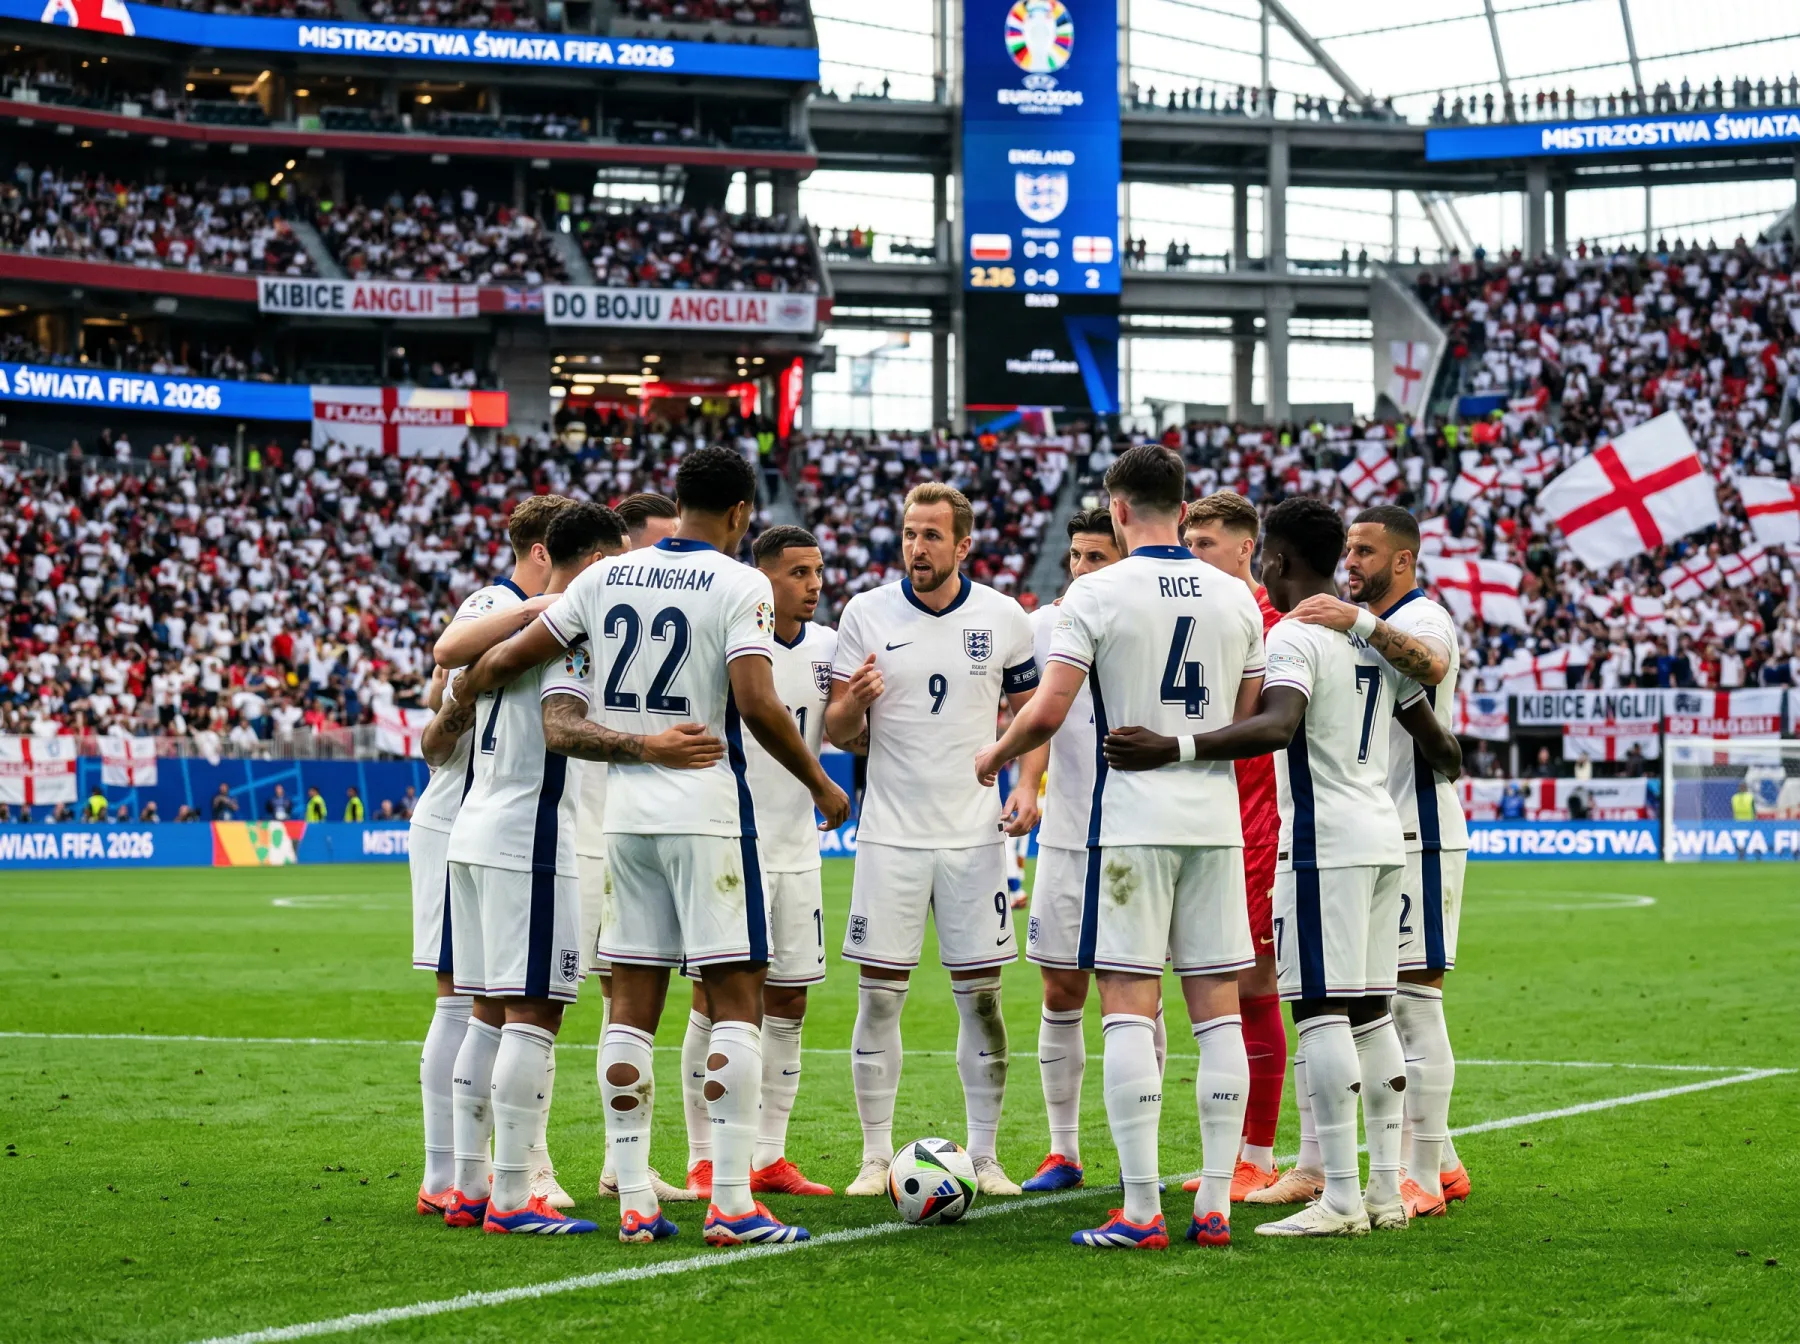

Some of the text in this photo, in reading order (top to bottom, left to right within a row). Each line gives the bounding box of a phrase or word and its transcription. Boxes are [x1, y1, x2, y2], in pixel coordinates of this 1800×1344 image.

[299, 26, 675, 68] MISTRZOSTWA ŚWIATA FIFA 2026
[1541, 120, 1710, 150] MISTRZOSTWA
[1008, 149, 1075, 166] ENGLAND
[1085, 268, 1100, 289] 2
[263, 282, 433, 312] KIBICE ANGLII
[553, 293, 768, 324] DO BOJU ANGLIA!
[14, 365, 105, 401] ŚWIATA
[108, 377, 160, 405] FIFA
[163, 382, 221, 410] 2026
[606, 565, 716, 591] BELLINGHAM
[1158, 576, 1202, 598] RICE
[604, 603, 692, 716] 22
[1160, 616, 1210, 720] 4
[928, 673, 948, 715] 9
[1522, 694, 1585, 720] KIBICE
[1591, 693, 1656, 720] ANGLII
[1355, 665, 1382, 765] 7
[61, 832, 105, 859] FIFA
[106, 831, 154, 859] 2026
[994, 891, 1007, 930] 9
